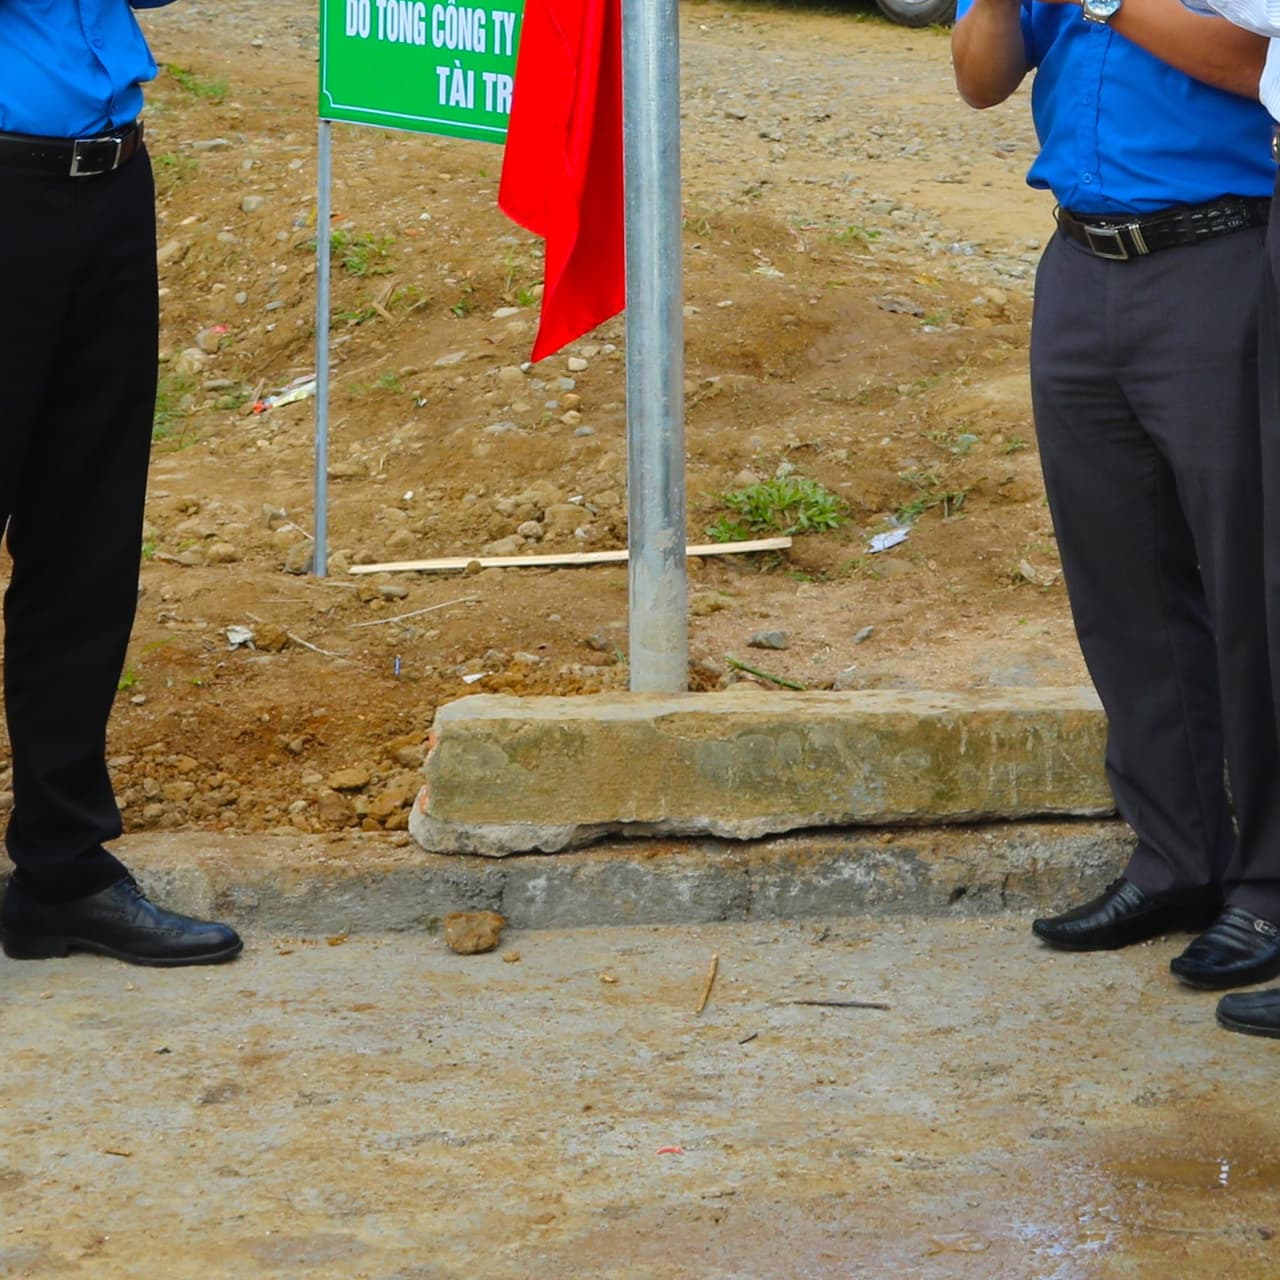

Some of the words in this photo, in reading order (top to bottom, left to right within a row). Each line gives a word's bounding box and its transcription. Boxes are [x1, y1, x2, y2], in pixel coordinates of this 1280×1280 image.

[491, 10, 516, 56] TY
[436, 59, 475, 109] TÀI
[482, 71, 514, 114] TR
